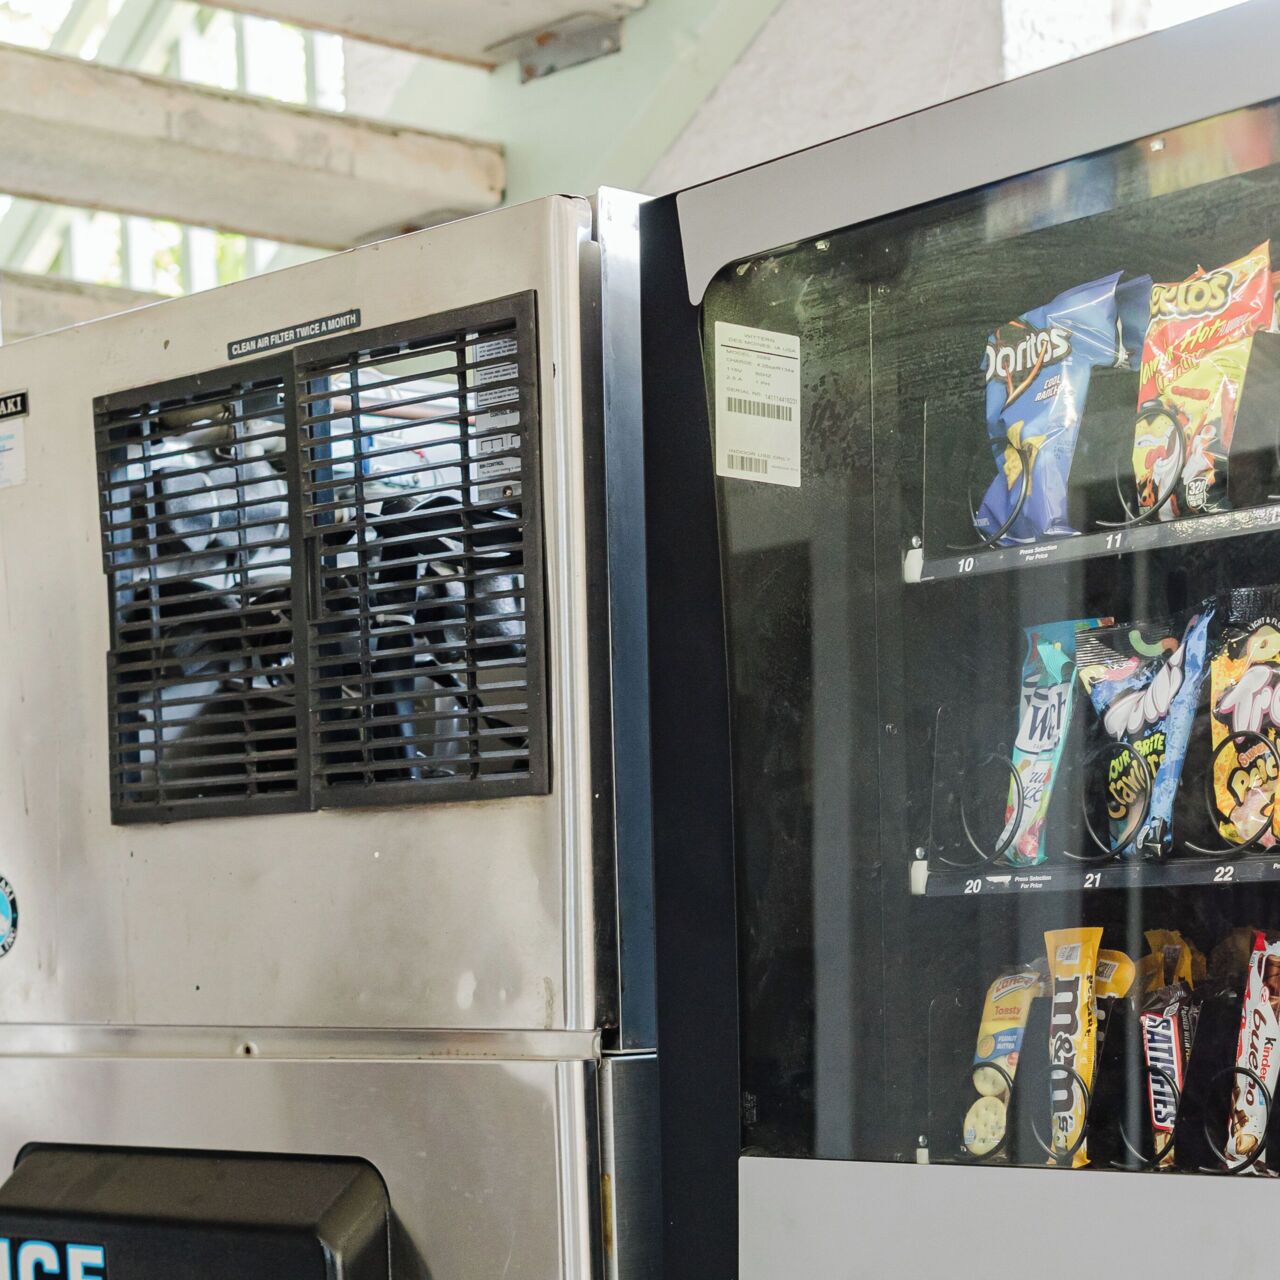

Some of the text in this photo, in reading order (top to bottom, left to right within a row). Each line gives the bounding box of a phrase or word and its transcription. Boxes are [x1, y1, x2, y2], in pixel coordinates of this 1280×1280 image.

[232, 313, 357, 355] CLEAN AIR FILTER TWICE A MONTH
[986, 328, 1070, 381] Doritos
[1105, 533, 1122, 550] 11
[1019, 544, 1058, 556] Press Selection
[1025, 552, 1049, 562] For Price
[957, 557, 974, 573] 10
[1029, 874, 1053, 883] Selection
[1083, 873, 1102, 889] 21
[1213, 866, 1235, 882] 22
[964, 879, 982, 895] 20
[1020, 881, 1044, 891] For Price
[994, 1004, 1023, 1017] Toasty
